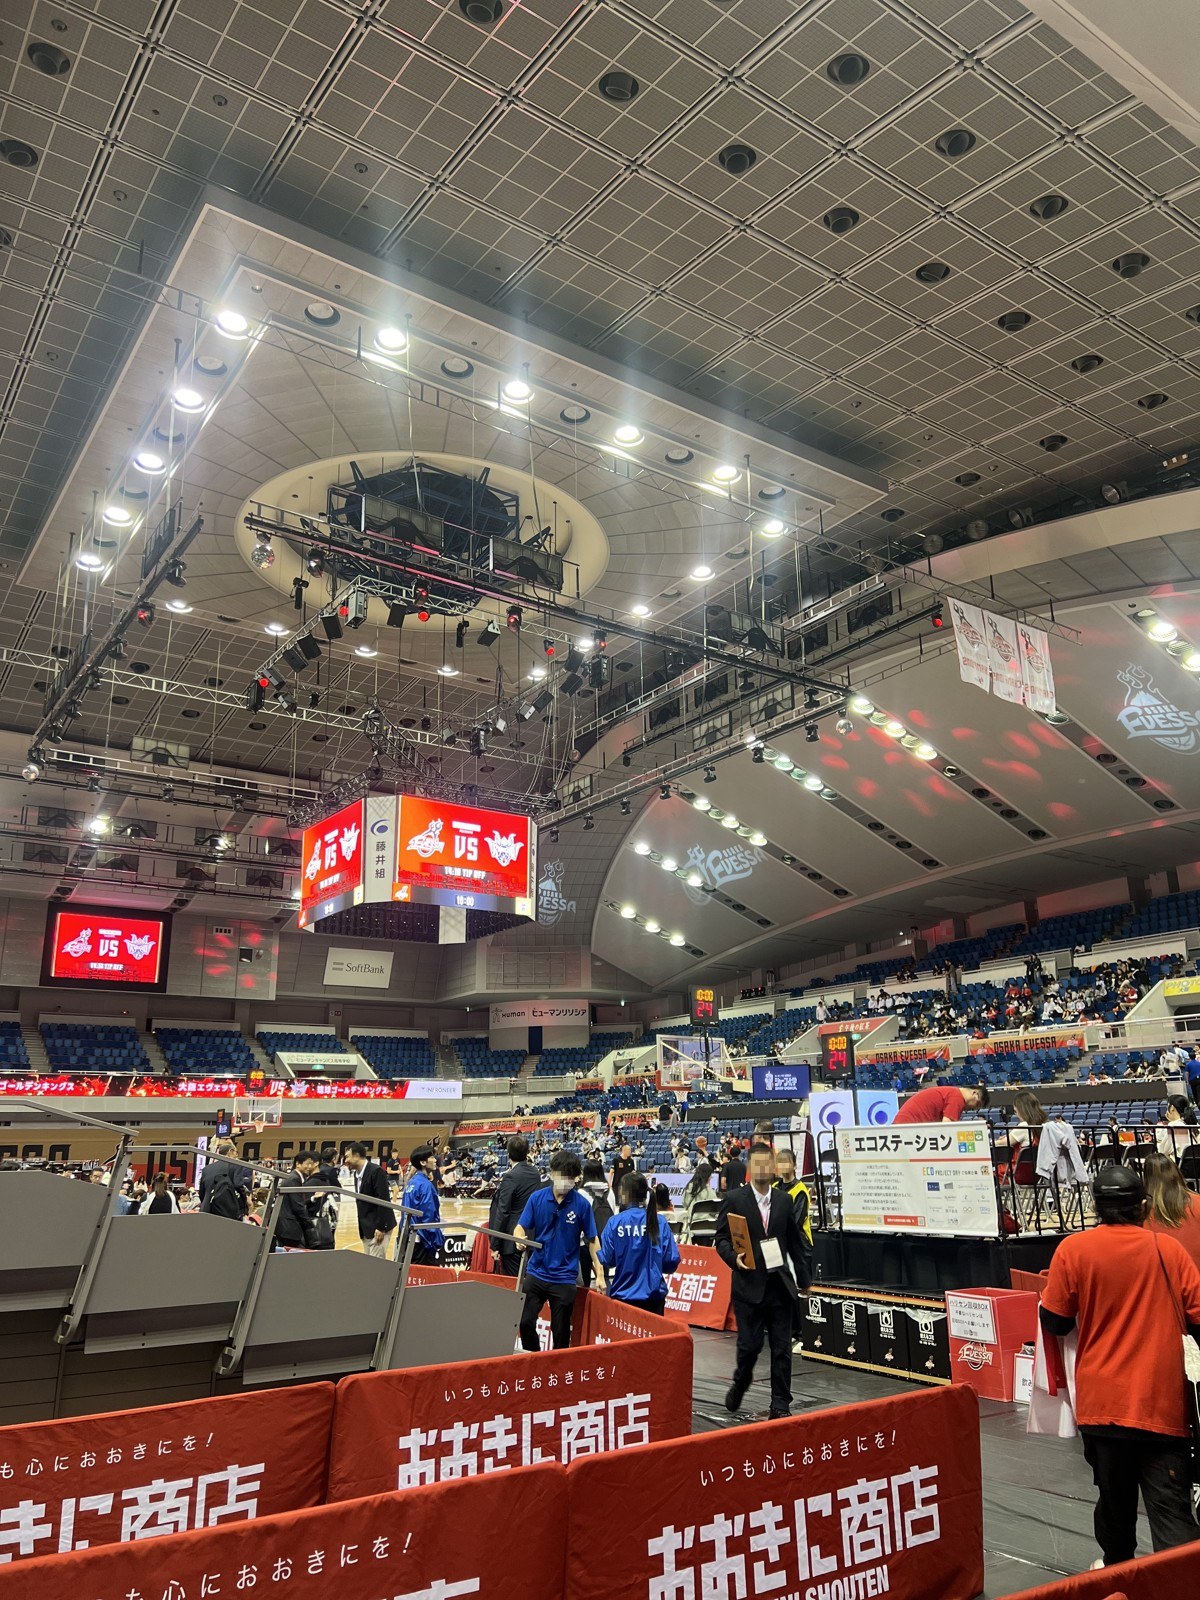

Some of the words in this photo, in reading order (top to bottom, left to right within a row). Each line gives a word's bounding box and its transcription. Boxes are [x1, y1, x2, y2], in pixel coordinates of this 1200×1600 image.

[324, 844, 337, 870] VS
[454, 835, 479, 861] VS
[374, 840, 386, 879] 藤井組
[98, 939, 119, 957] VS
[345, 962, 385, 974] SoftBank
[696, 989, 714, 1002] 10:00
[531, 1007, 587, 1017] ヒューマンリソシア
[696, 1002, 713, 1017] 24
[828, 1036, 847, 1050] 10:00
[994, 1040, 1021, 1053] OSAKA
[1023, 1036, 1057, 1050] EVESSA
[829, 1051, 847, 1070] 24
[875, 1052, 898, 1063] OSAKA
[900, 1049, 927, 1061] EVESSA
[178, 1082, 237, 1092] 大阪エヴェッサ
[269, 1081, 286, 1095] VS
[854, 1134, 952, 1153] エコステーション
[922, 1167, 934, 1176] ECO
[617, 1225, 647, 1237] STAF
[662, 1272, 718, 1303] に商店
[444, 1366, 616, 1403] いつも心におおきにを！
[398, 1393, 651, 1490] おおきに商店
[700, 1430, 896, 1487] いつも心におおきにを！
[647, 1465, 941, 1600] おおきに商店
[805, 1564, 890, 1600] SHOUTEN
